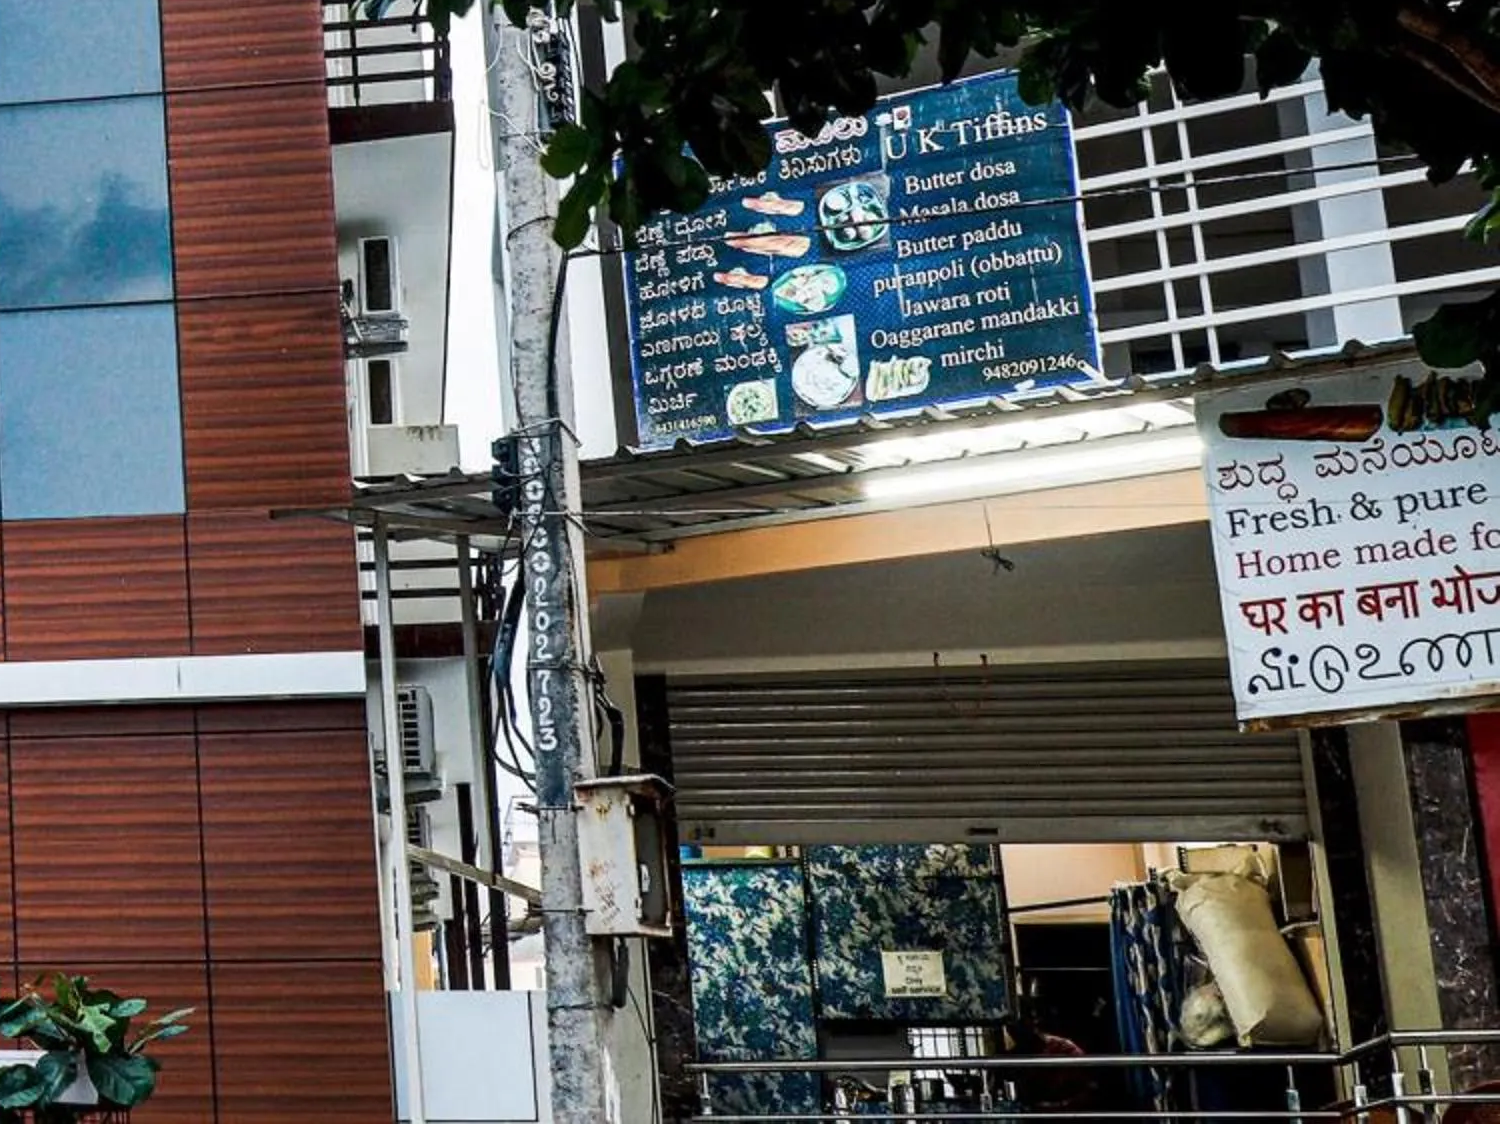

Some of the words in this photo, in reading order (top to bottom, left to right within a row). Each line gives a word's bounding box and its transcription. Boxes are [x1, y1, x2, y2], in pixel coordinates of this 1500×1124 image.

[886, 133, 907, 160] U
[917, 127, 944, 155] K
[952, 111, 1048, 146] Tiffins
[905, 169, 964, 195] Butter
[970, 159, 1016, 181] dosa
[900, 196, 970, 224] Masala
[974, 189, 1020, 212] dosa
[897, 232, 957, 259] Butter
[963, 219, 1023, 251] paddu
[873, 258, 965, 297] puranpoli
[971, 241, 1062, 278] (obbattu)
[871, 318, 976, 349] Oaggarane
[981, 295, 1080, 330] mandakki
[902, 292, 971, 318] Jawara
[977, 281, 1011, 304] roti
[940, 339, 1006, 368] mirchi
[1226, 497, 1336, 538] Fresh
[1350, 491, 1382, 521] &
[1394, 482, 1488, 525] pure
[1236, 547, 1341, 579] Home
[1354, 528, 1458, 565] made
[1239, 597, 1288, 636] घर
[1296, 589, 1345, 629] का
[1356, 580, 1420, 622] बना
